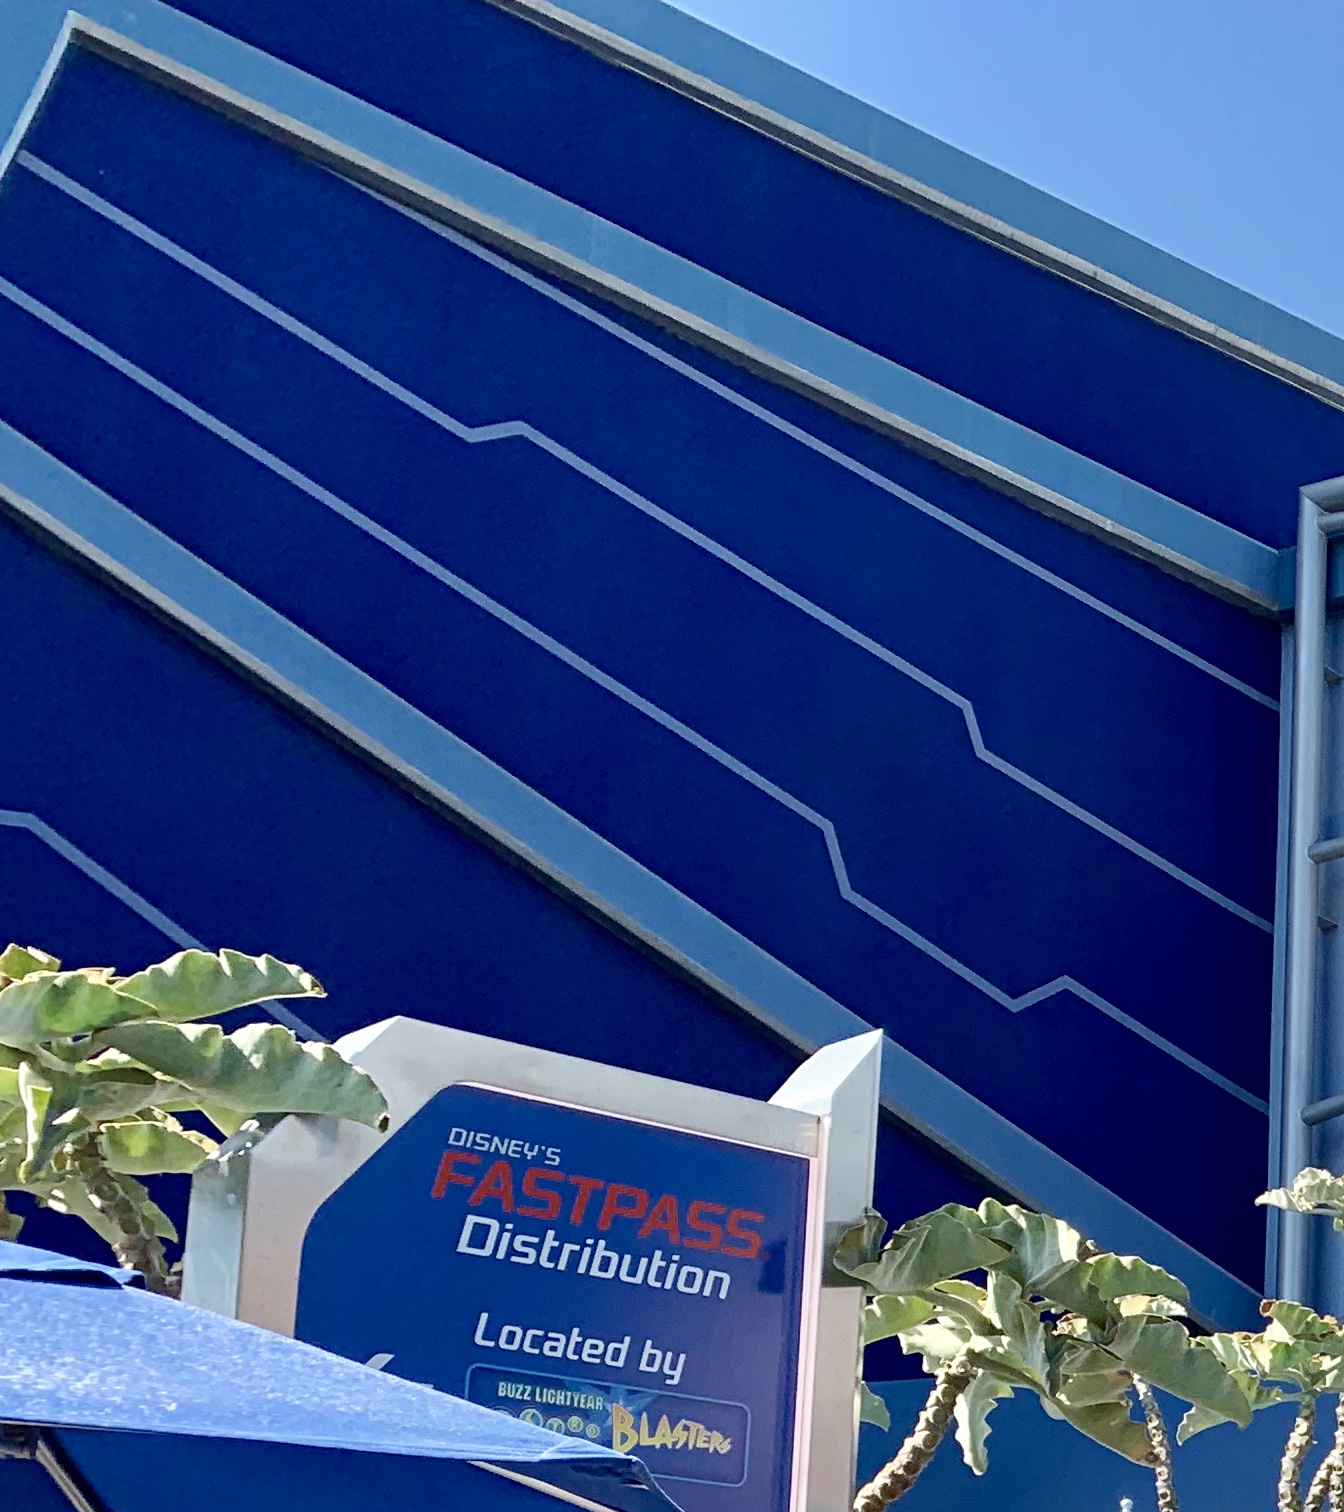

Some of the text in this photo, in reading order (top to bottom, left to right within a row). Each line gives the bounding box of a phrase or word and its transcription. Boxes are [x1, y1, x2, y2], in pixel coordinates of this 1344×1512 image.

[448, 1127, 562, 1167] DISNEY'S
[429, 1150, 766, 1261] FASTPASS
[456, 1213, 732, 1300] Distribution
[473, 1312, 687, 1386] Located by
[498, 1381, 605, 1411] BUZZ LIGHTYEAR
